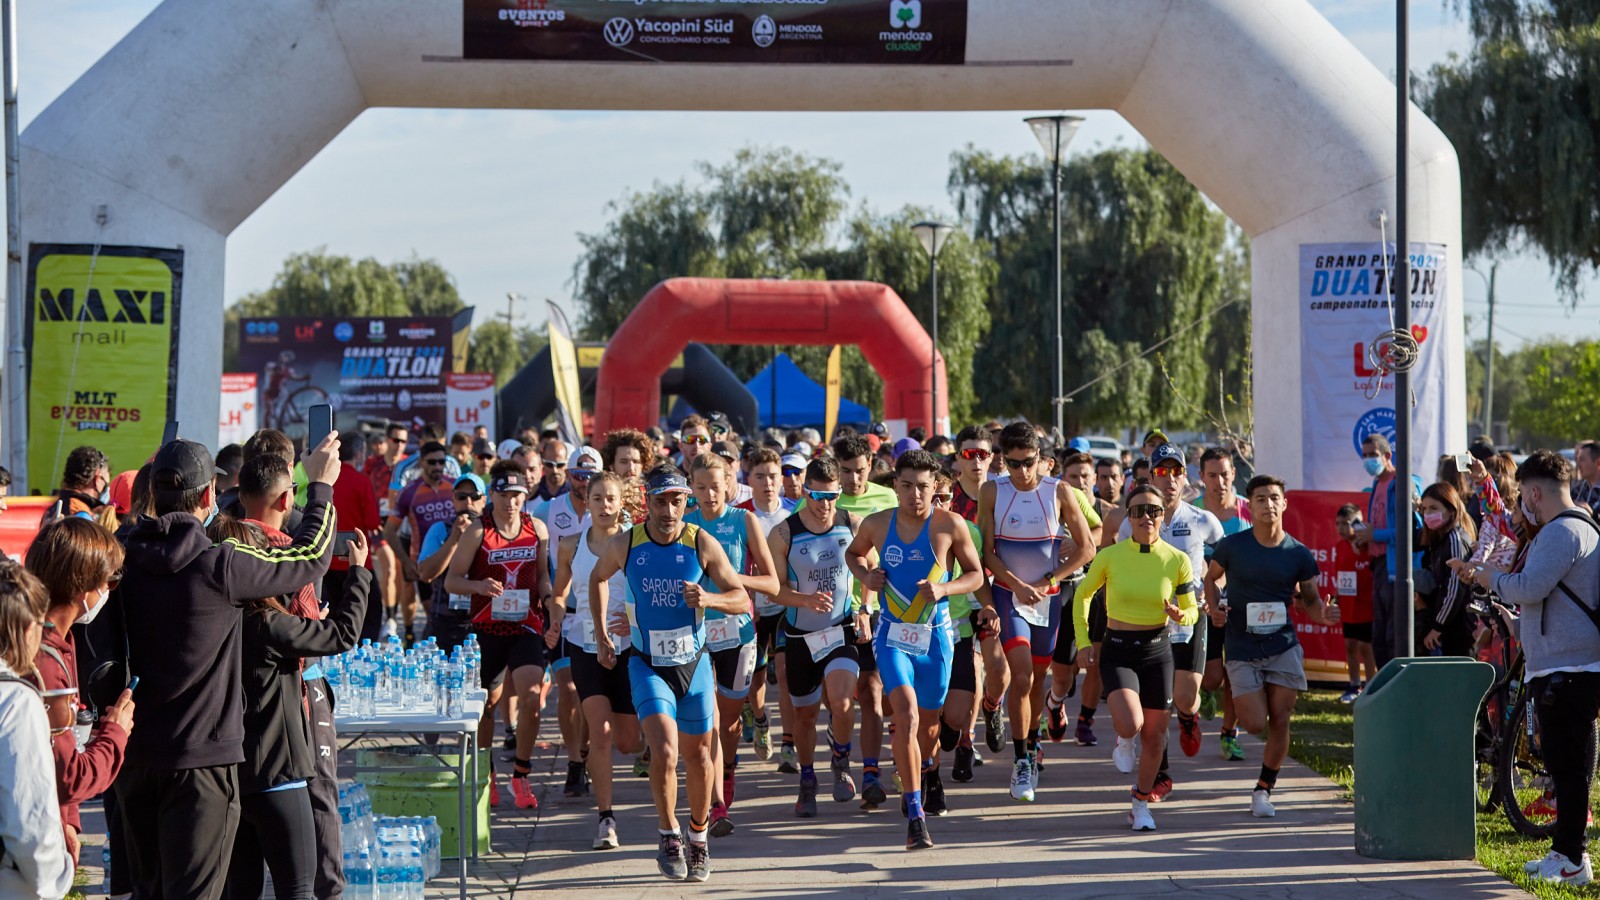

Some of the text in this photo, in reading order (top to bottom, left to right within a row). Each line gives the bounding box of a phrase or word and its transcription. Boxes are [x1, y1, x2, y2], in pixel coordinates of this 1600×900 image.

[635, 18, 733, 35] Yacopini Süd
[778, 24, 823, 33] MENDOZA
[879, 31, 932, 41] mendoza
[885, 40, 922, 51] ciudad
[1316, 255, 1366, 268] GRAND
[39, 287, 165, 324] MAXI
[1311, 299, 1378, 311] campeonato
[72, 329, 126, 344] mall
[341, 356, 444, 377] DUATLON
[74, 391, 117, 405] MLT
[454, 407, 478, 423] LH
[1361, 414, 1375, 426] SAN
[78, 421, 110, 431] SPORT
[491, 549, 534, 561] PUSH
[808, 565, 842, 582] AGUILERA
[817, 579, 836, 592] ARG
[503, 599, 519, 611] 51
[652, 593, 676, 607] ARG
[1258, 611, 1275, 623] 47
[709, 627, 727, 641] 21
[821, 632, 829, 646] 1
[900, 629, 918, 644] 30
[313, 686, 331, 757] AIR
